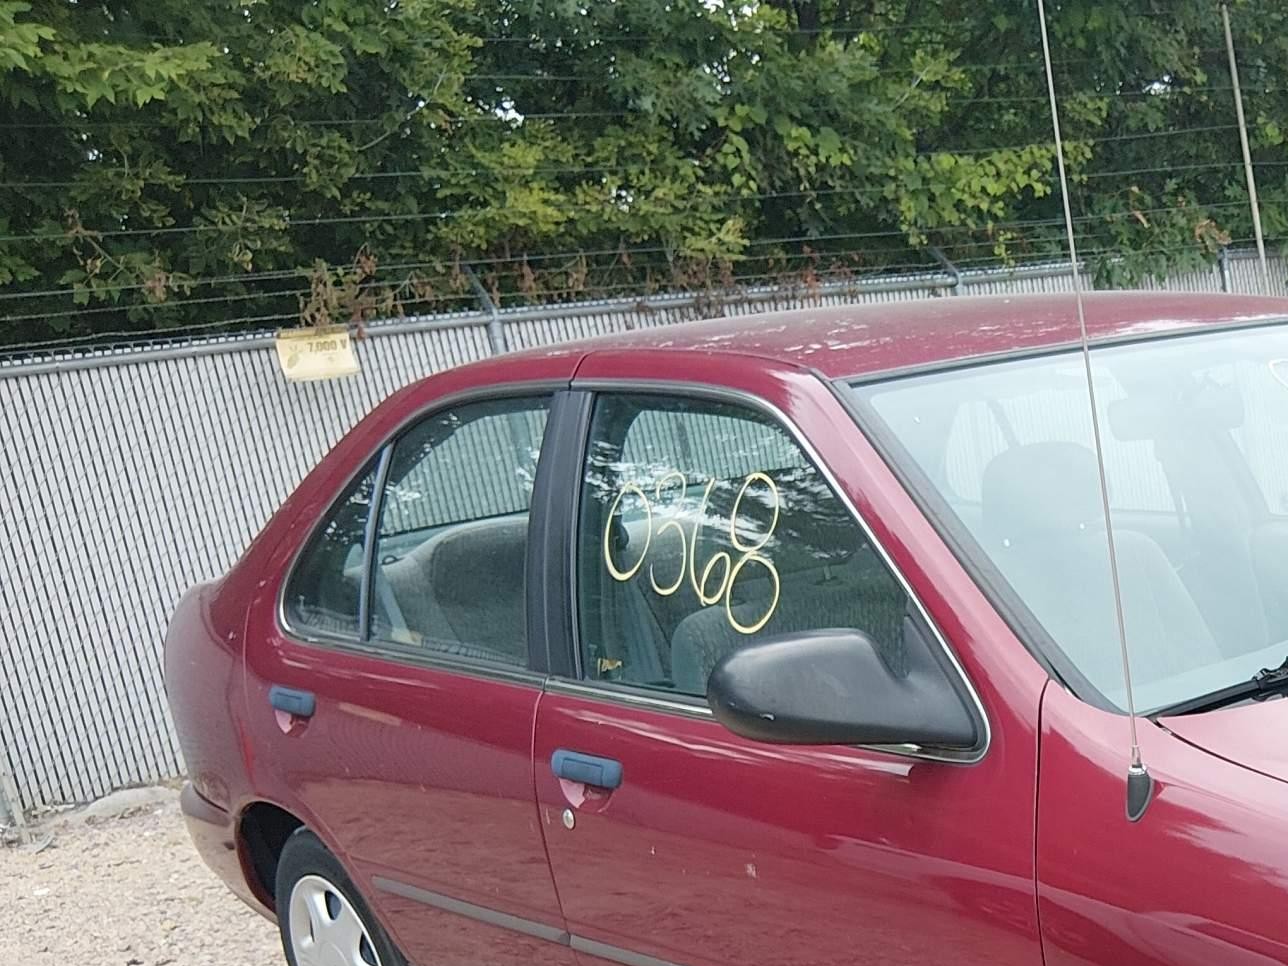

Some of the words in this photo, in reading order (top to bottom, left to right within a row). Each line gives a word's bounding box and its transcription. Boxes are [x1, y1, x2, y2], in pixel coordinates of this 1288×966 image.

[307, 341, 338, 354] 7,000
[340, 339, 347, 350] V
[604, 471, 780, 634] 0368
